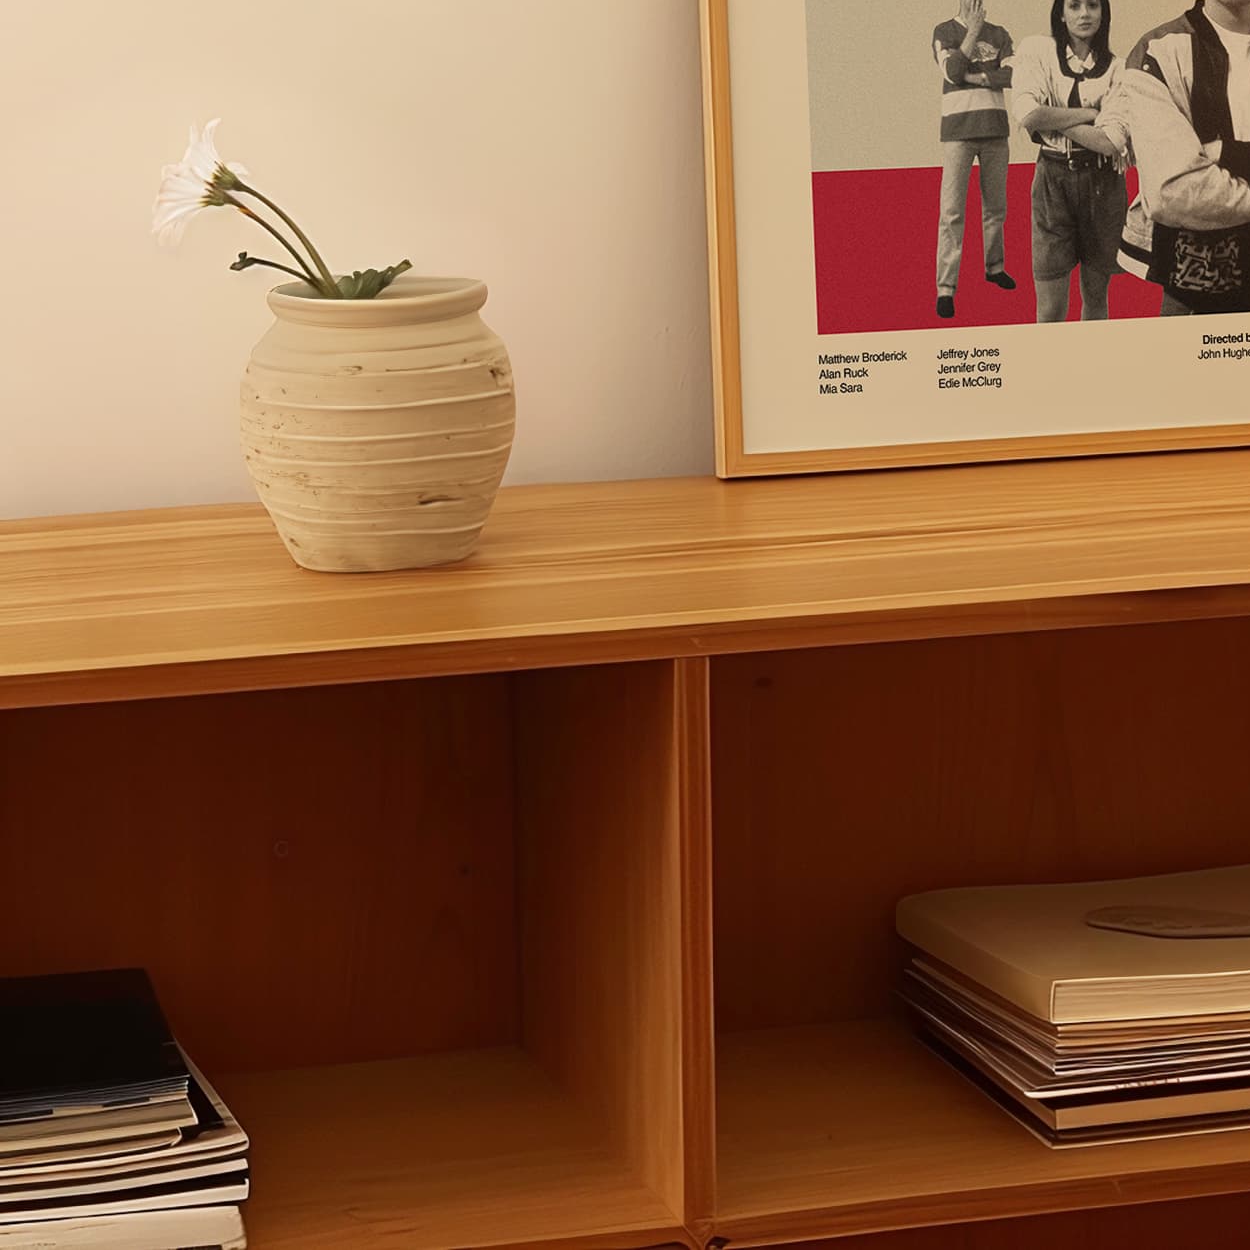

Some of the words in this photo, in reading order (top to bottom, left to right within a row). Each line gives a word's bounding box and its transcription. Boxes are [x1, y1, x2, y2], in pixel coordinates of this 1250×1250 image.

[1202, 333, 1244, 345] Directed
[818, 353, 860, 365] Matthew
[862, 351, 908, 362] Broderick
[937, 349, 969, 361] Jeffrey
[970, 347, 1000, 358] Jones
[1197, 350, 1221, 360] John
[819, 369, 841, 380] Alan
[843, 367, 869, 378] Ruck
[937, 363, 976, 375] Jennifer
[977, 362, 1001, 374] Grey
[819, 384, 838, 395] Mia
[840, 383, 863, 393] Sara
[938, 378, 960, 389] Edie
[962, 376, 1002, 388] McClurg
